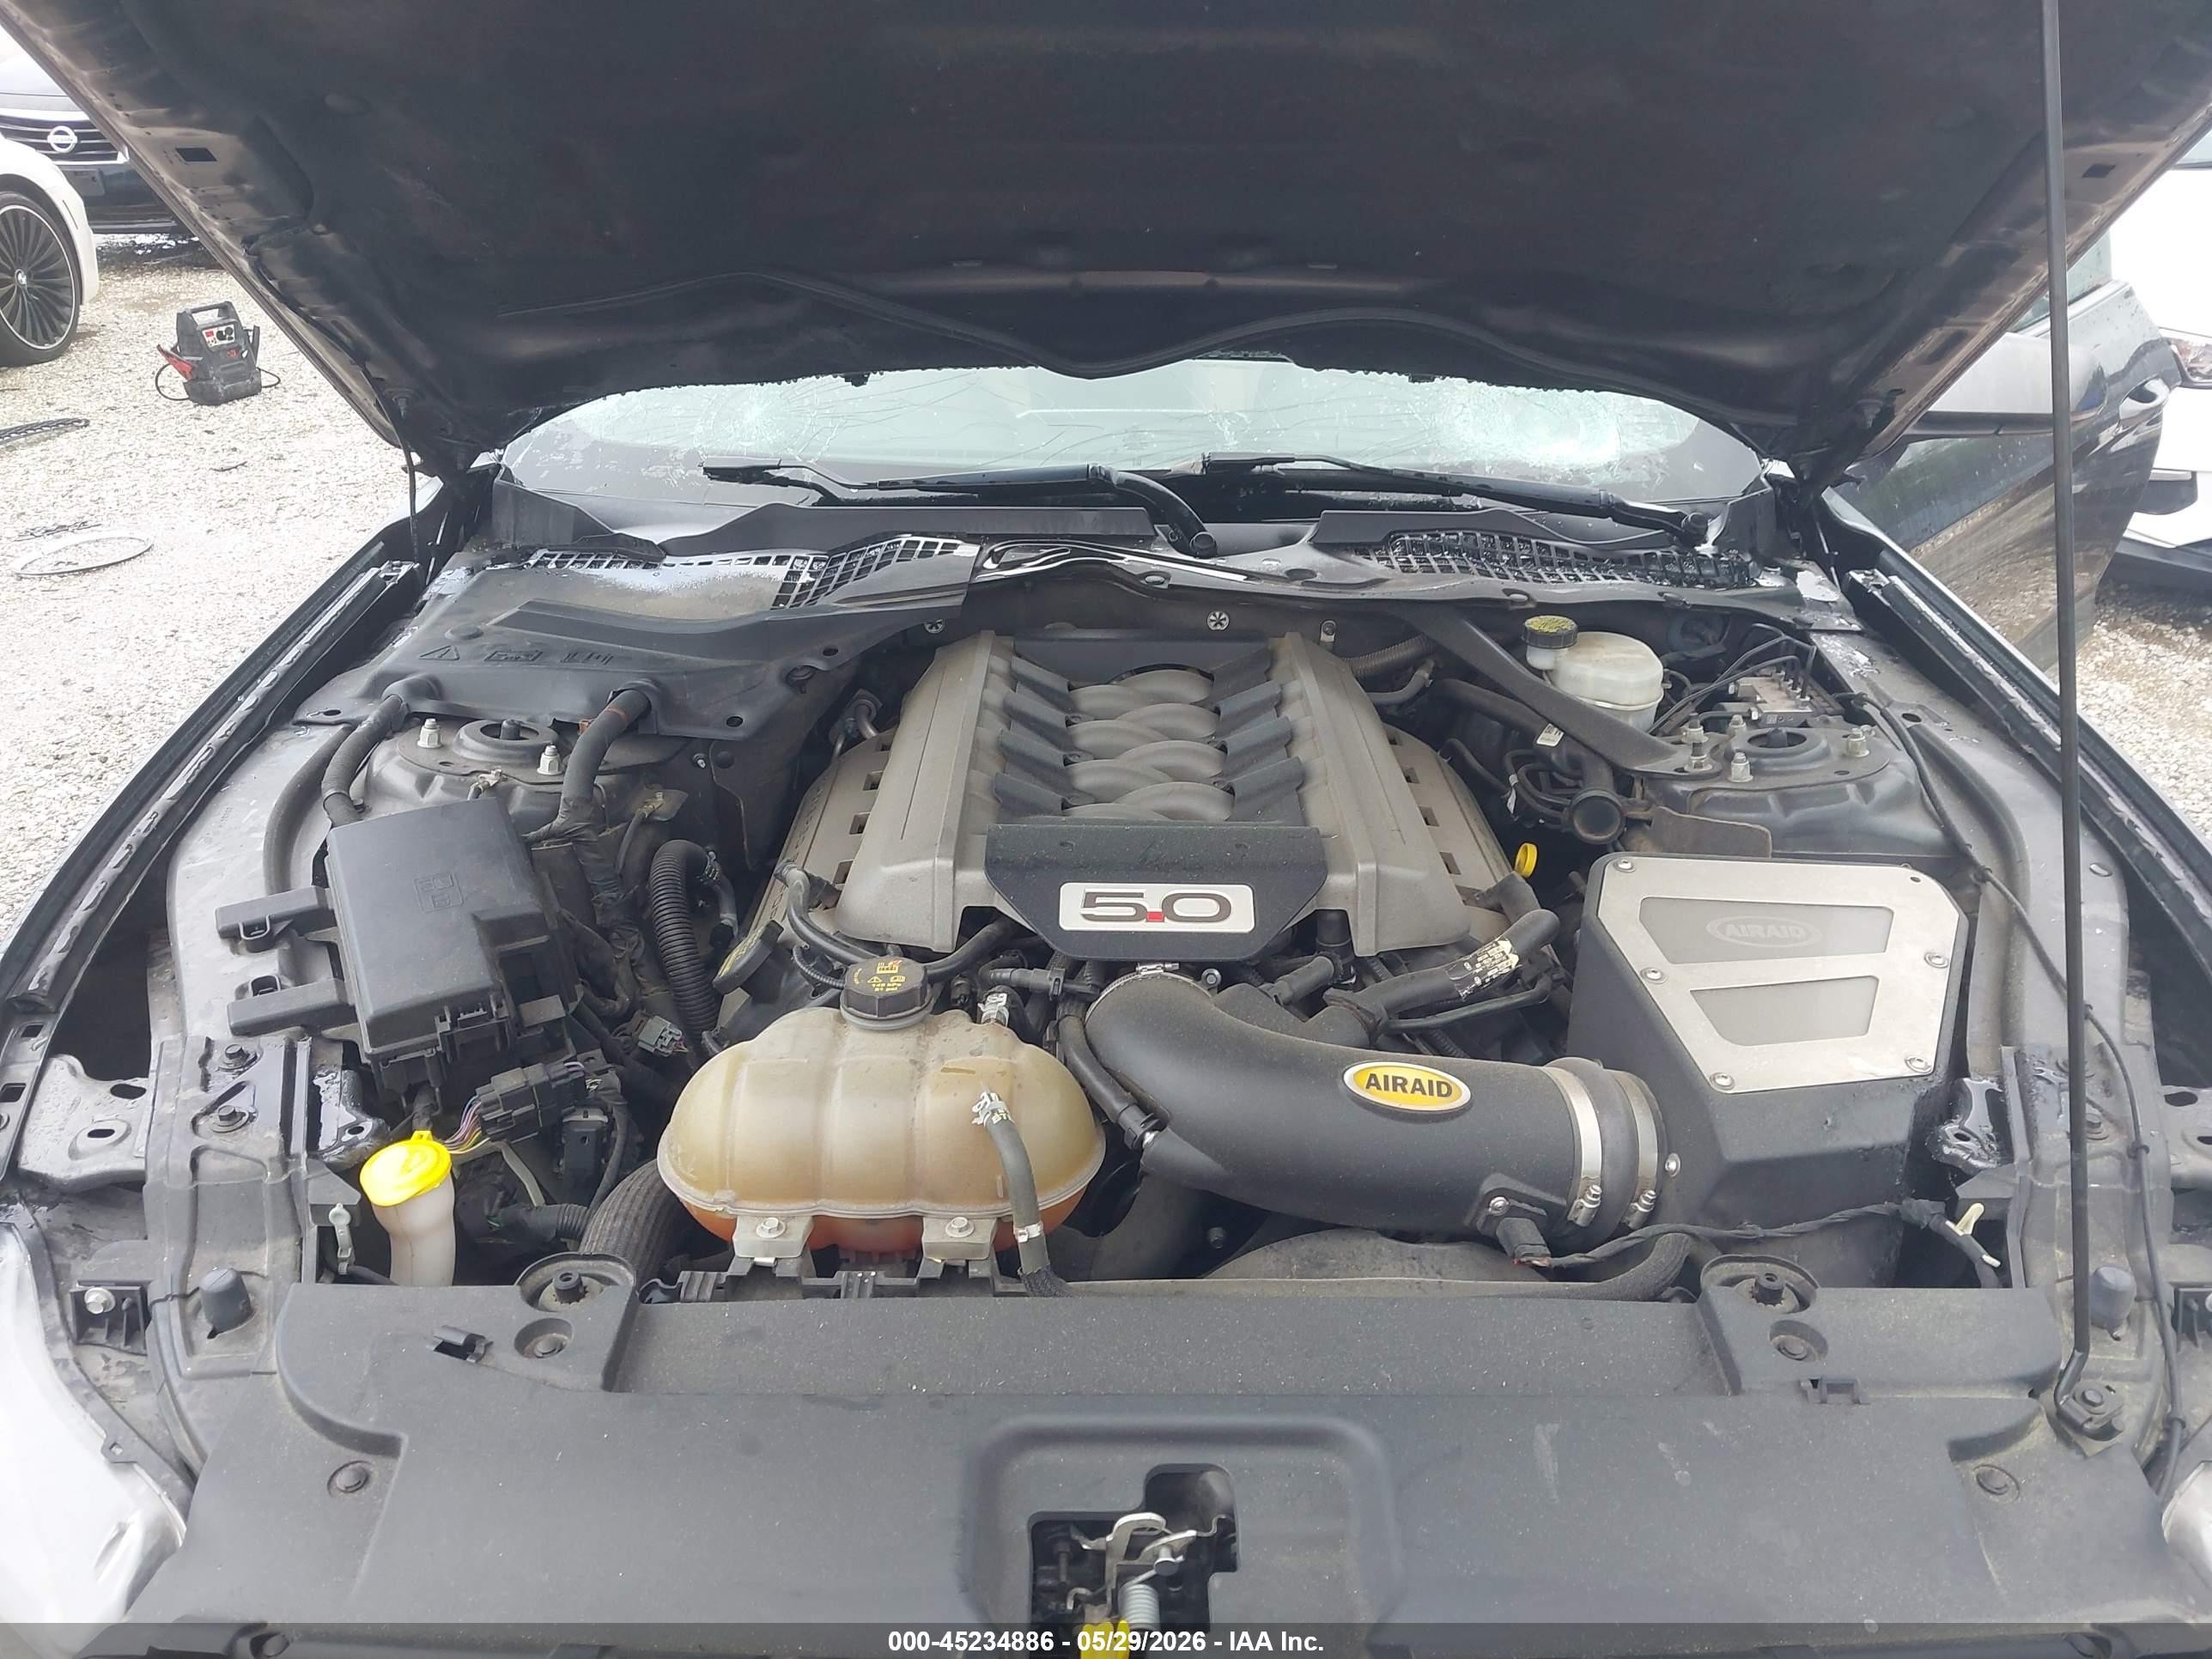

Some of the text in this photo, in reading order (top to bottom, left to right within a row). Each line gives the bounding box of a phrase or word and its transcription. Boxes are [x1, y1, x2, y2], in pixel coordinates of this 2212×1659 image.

[1079, 890, 1232, 923] 5.0
[1725, 923, 1806, 939] AIRAID
[1365, 1073, 1453, 1098] AIRAID
